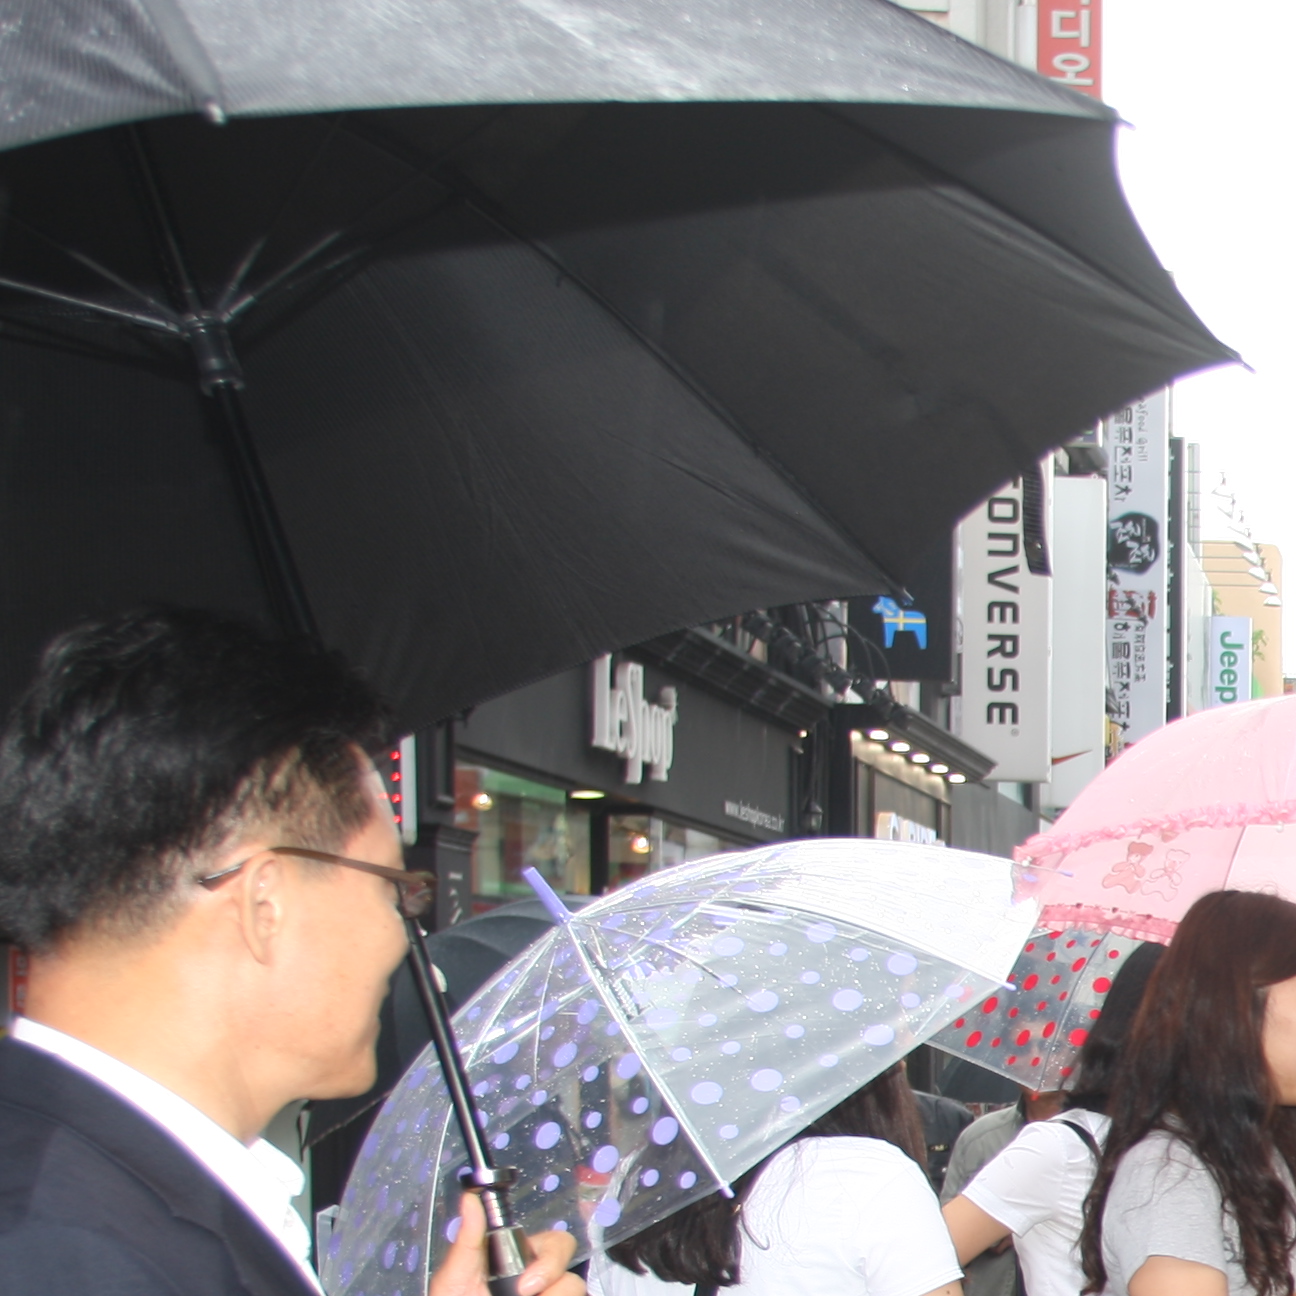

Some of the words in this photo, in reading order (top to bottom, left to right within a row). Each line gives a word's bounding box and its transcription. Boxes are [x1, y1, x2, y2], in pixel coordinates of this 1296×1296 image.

[1050, 6, 1094, 87] 디오
[987, 482, 1020, 725] ONVERSE
[1214, 630, 1245, 705] Jeep
